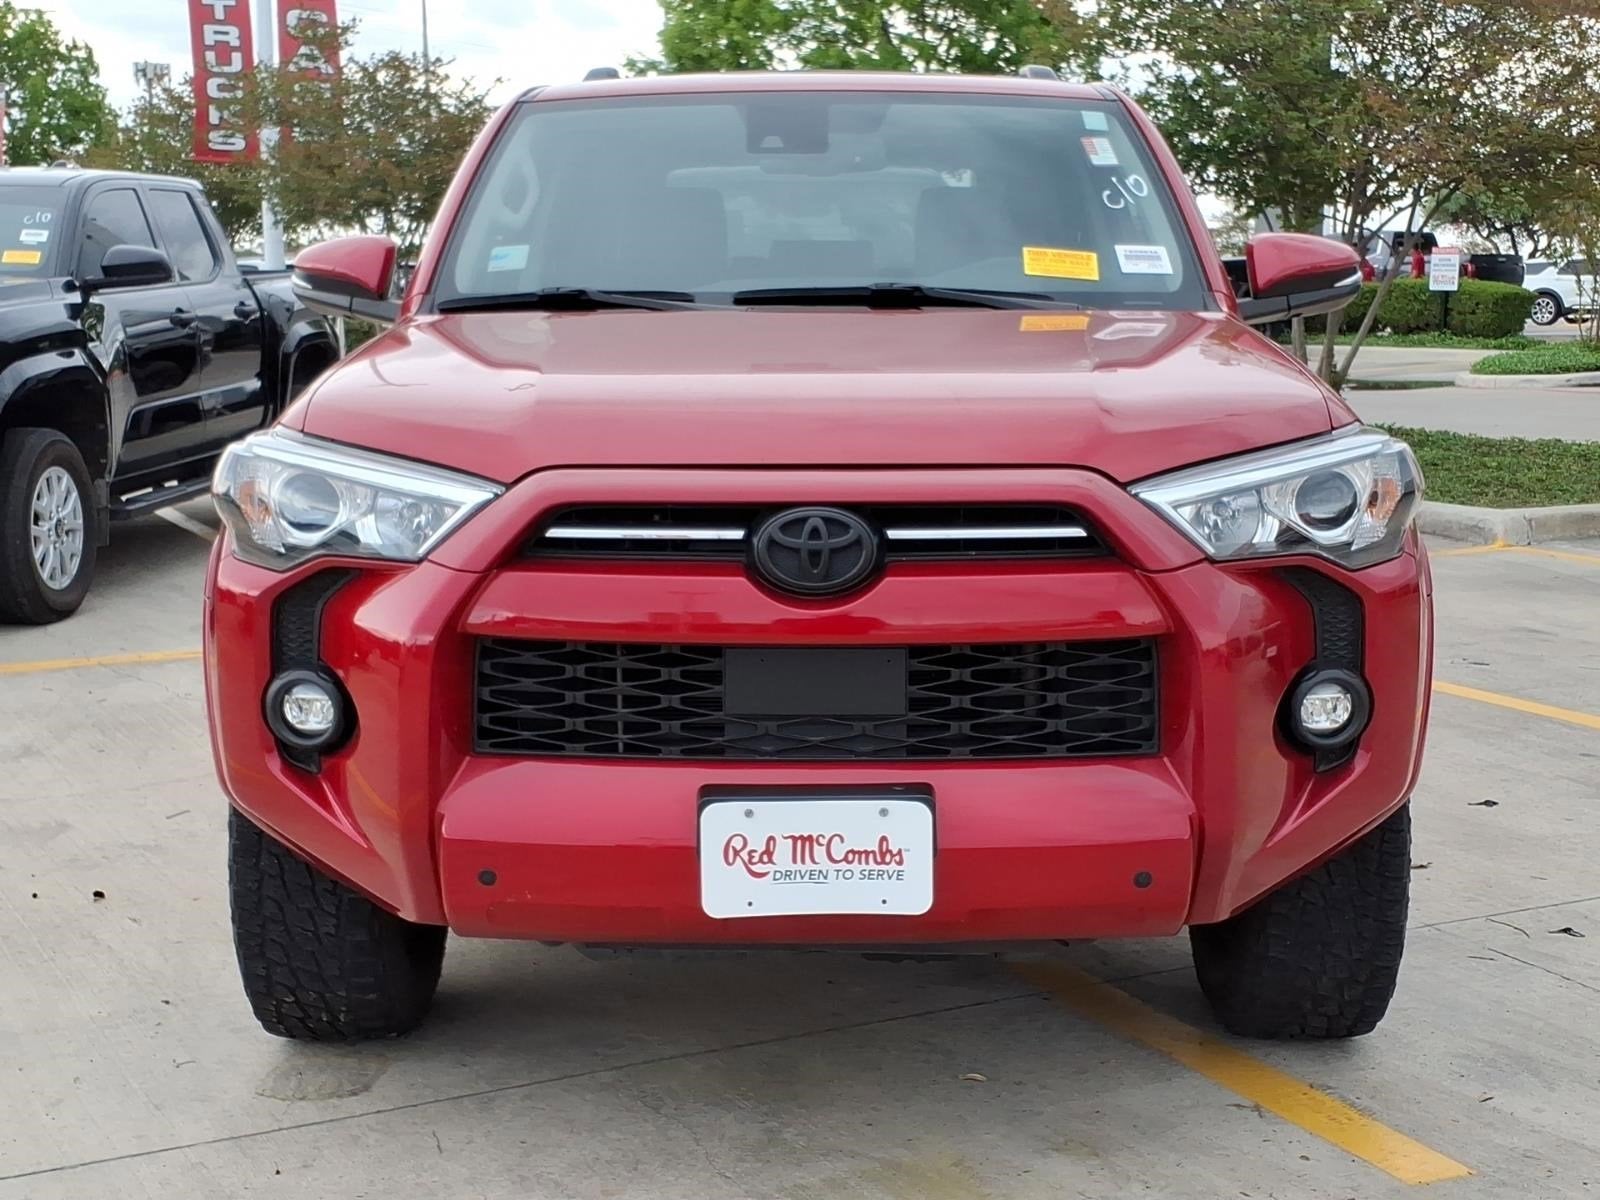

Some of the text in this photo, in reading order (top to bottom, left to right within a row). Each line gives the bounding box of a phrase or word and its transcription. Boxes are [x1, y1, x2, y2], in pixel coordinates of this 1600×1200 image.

[723, 833, 905, 879] Red McCombs
[772, 869, 905, 881] DRIVEN TO SERVE
